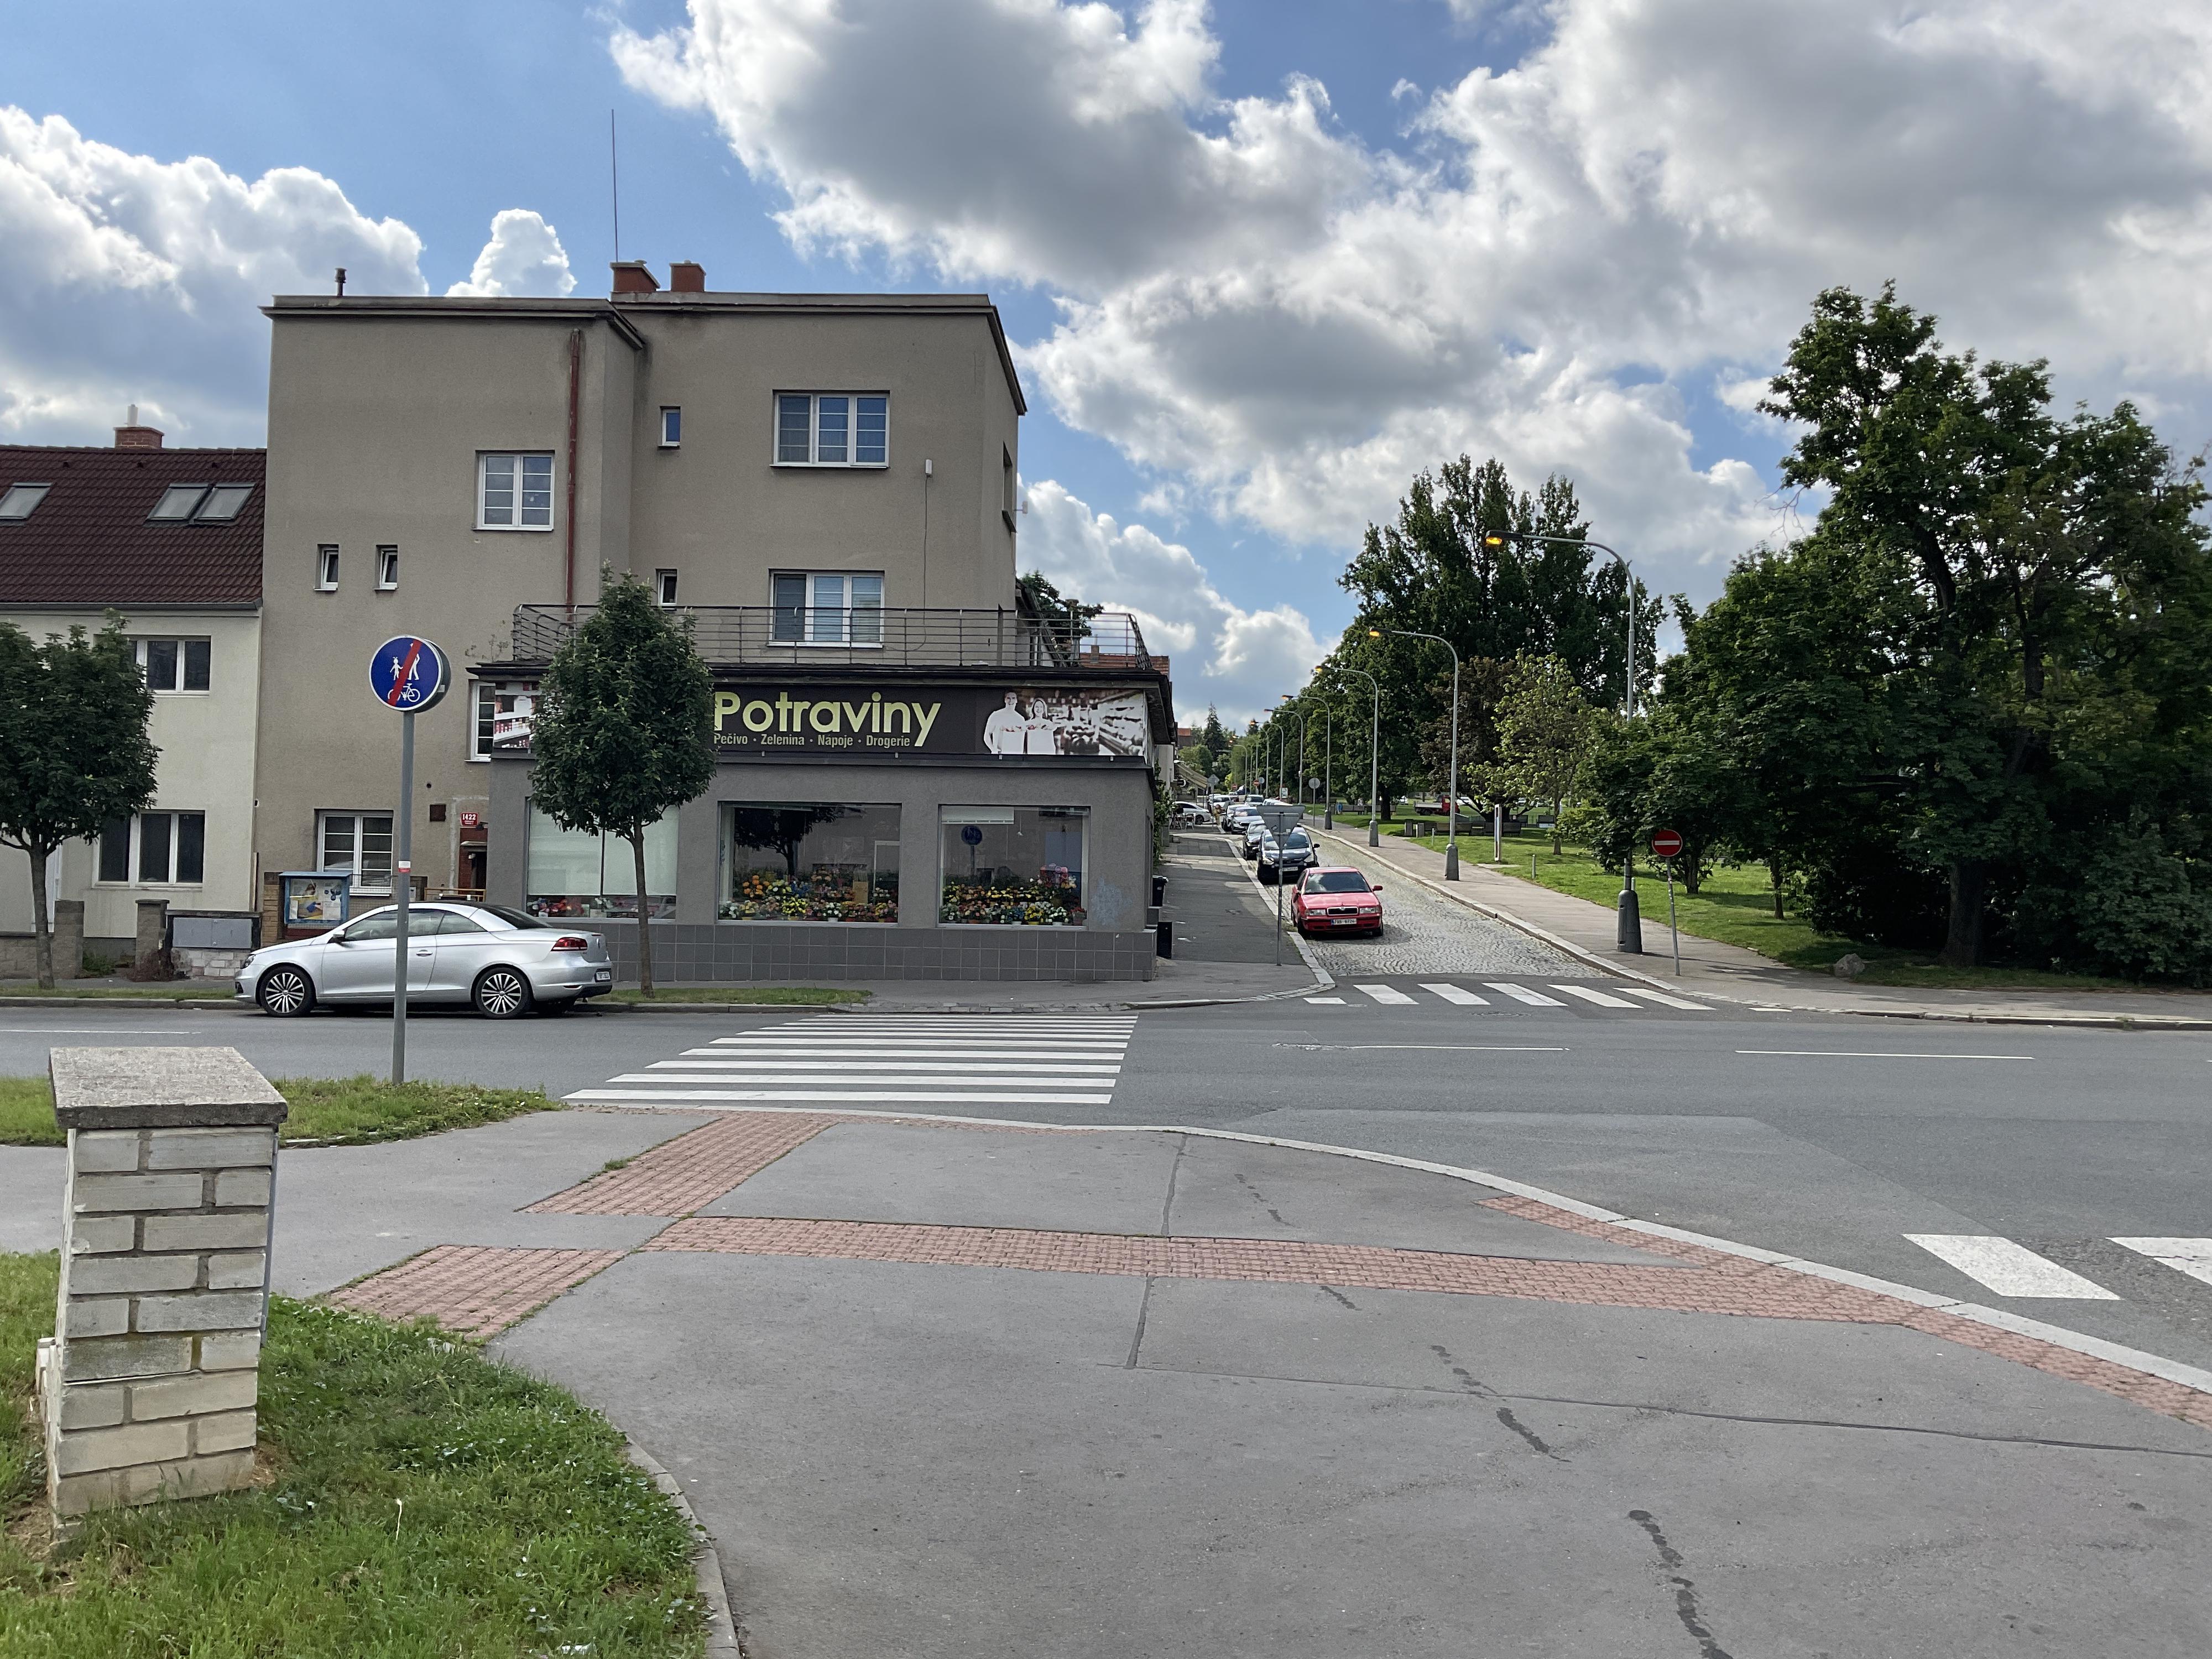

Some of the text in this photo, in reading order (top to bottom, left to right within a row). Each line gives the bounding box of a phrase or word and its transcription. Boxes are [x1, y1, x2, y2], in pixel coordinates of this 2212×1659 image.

[714, 691, 941, 747] Potraviny
[713, 733, 910, 749] Pečivo Zelenina Nápoje Drogerie
